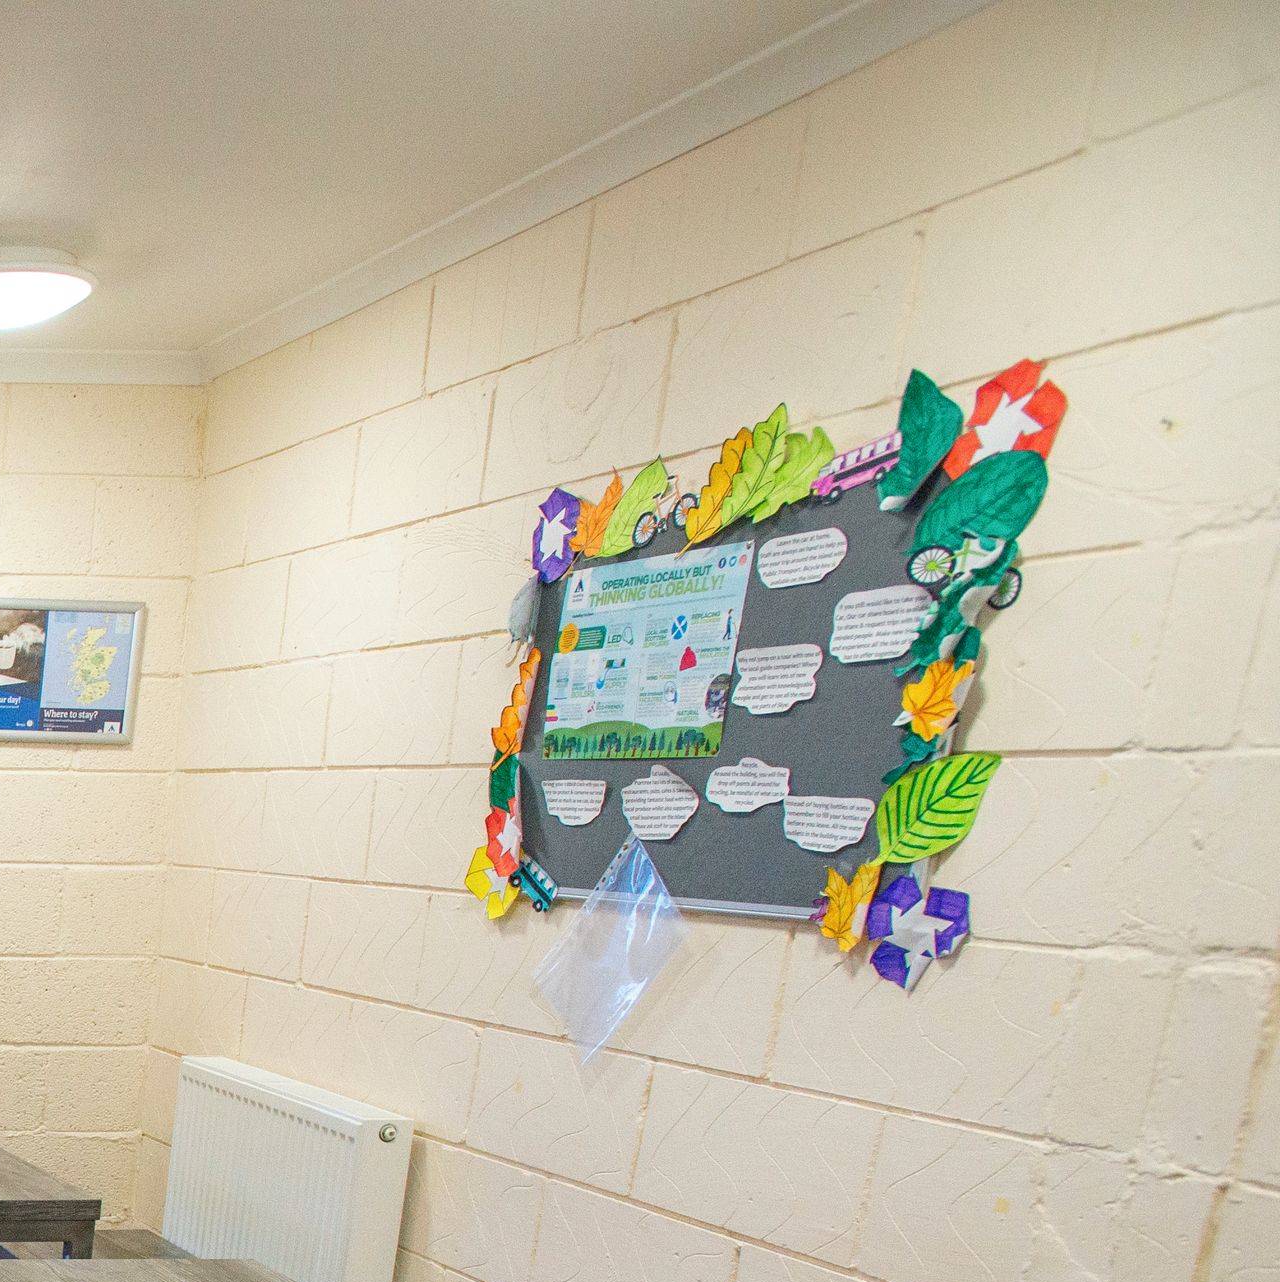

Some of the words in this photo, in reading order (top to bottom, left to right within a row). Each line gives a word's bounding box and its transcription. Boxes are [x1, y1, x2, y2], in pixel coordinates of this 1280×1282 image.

[602, 574, 649, 590] OPERATING
[650, 568, 691, 584] LOCALLY
[692, 564, 713, 578] BUT
[589, 585, 646, 607] THINKING
[649, 574, 725, 599] GLOBALLY!
[607, 634, 622, 644] LED
[7, 696, 21, 705] day!
[43, 709, 68, 719] Where
[69, 711, 77, 719] to
[78, 711, 98, 721] stay?
